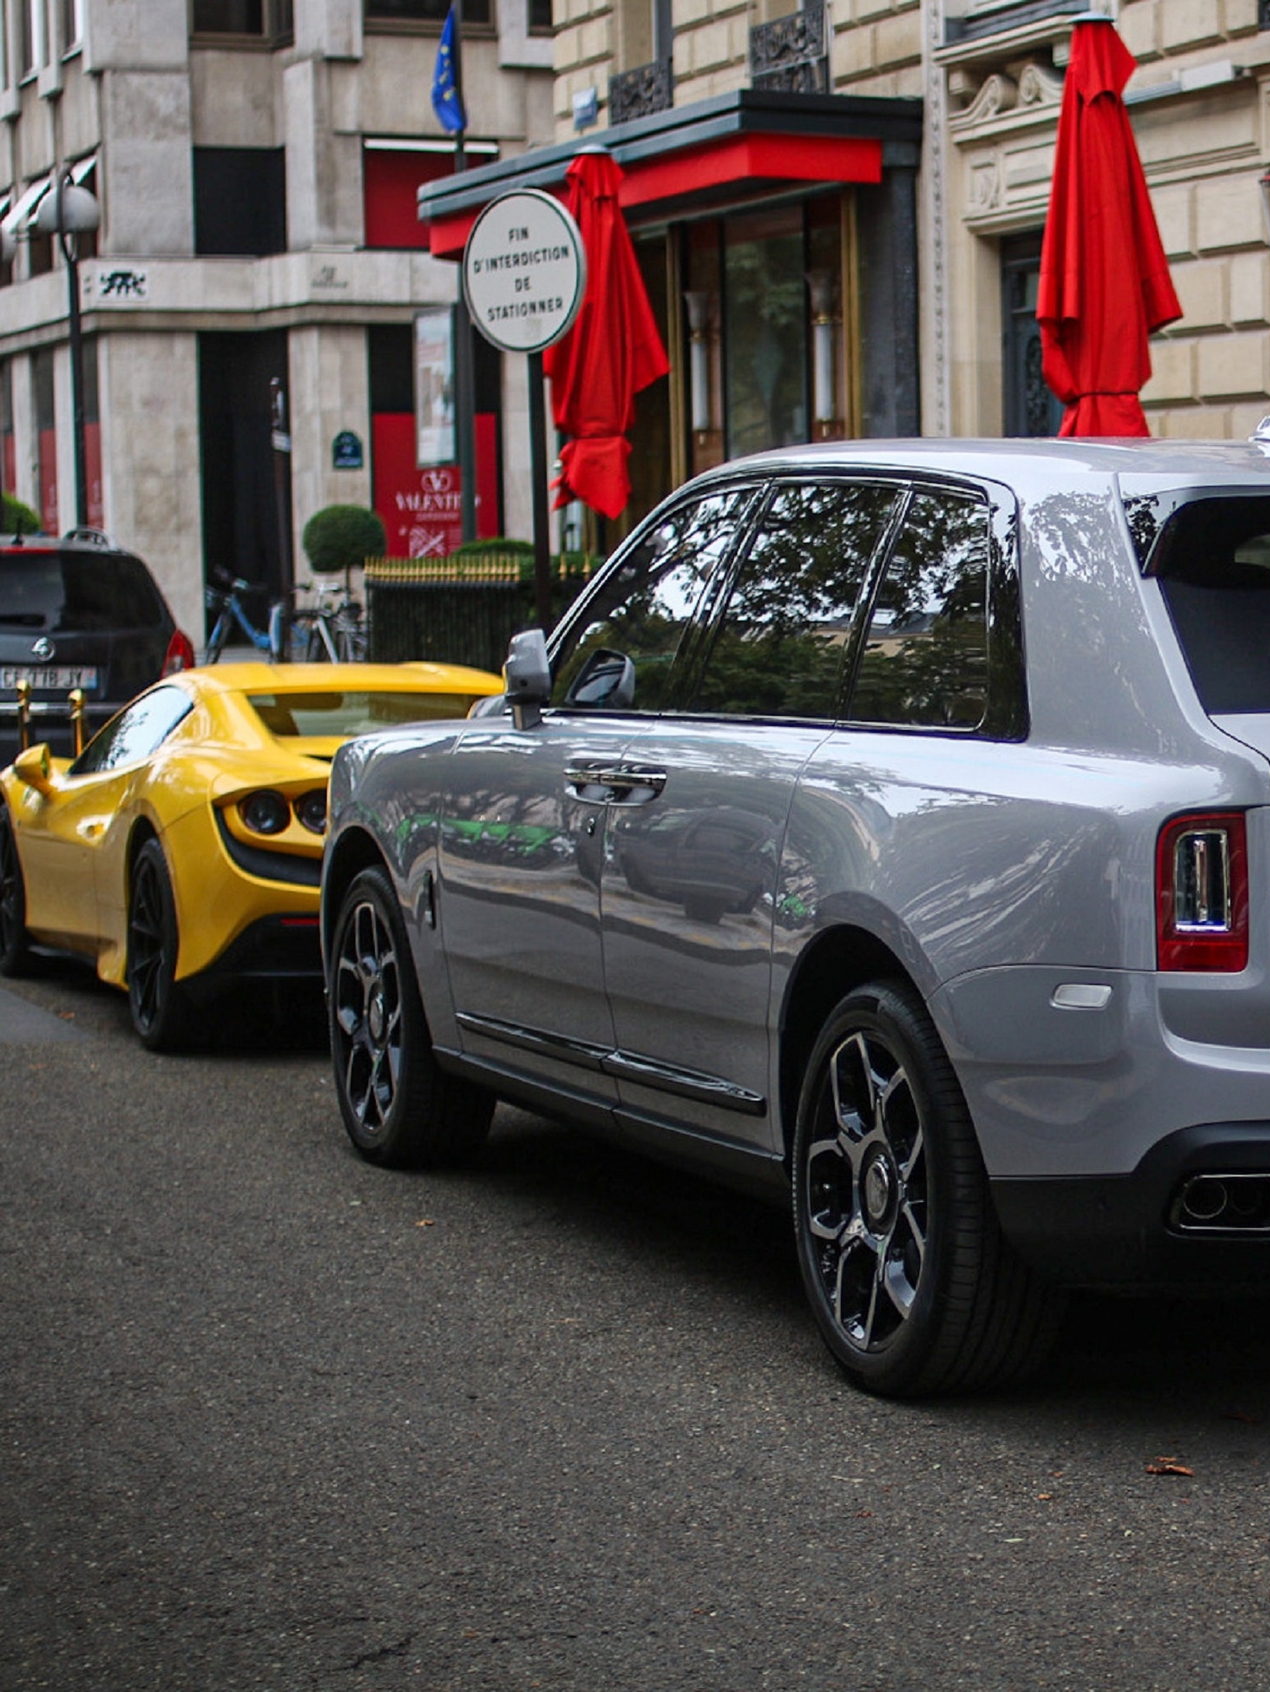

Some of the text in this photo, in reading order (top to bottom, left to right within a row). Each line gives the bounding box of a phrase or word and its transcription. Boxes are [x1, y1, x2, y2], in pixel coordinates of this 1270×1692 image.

[508, 226, 529, 243] FIN
[473, 245, 570, 274] D'INTERDICTION
[514, 276, 531, 293] DE
[487, 297, 564, 322] STATIONNER
[395, 490, 482, 512] VALENTI
